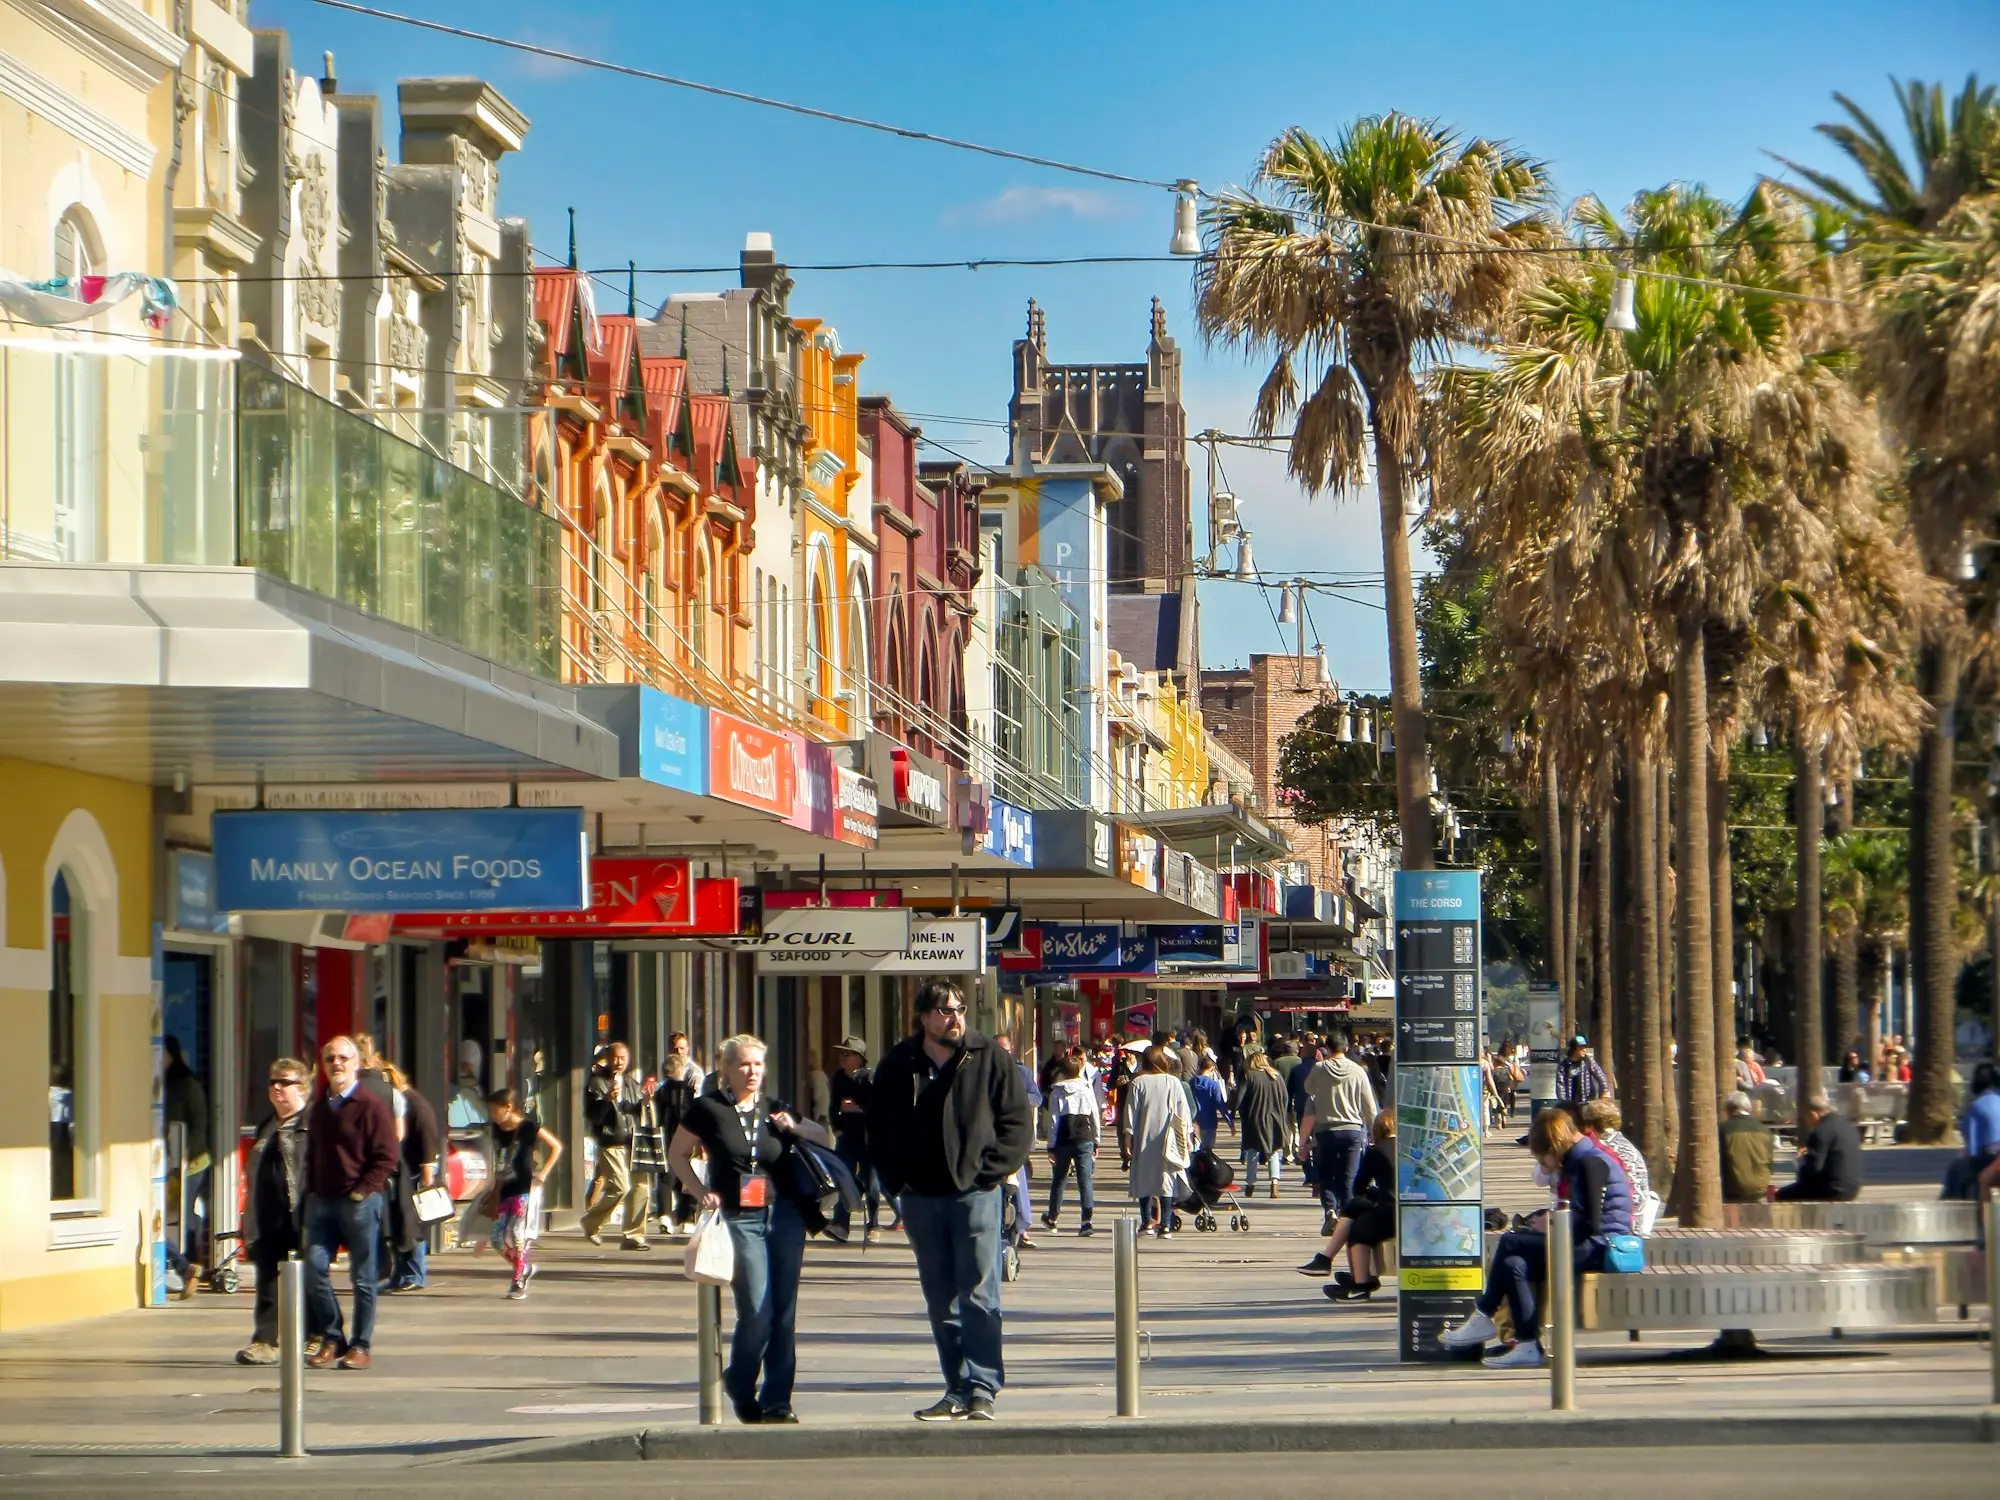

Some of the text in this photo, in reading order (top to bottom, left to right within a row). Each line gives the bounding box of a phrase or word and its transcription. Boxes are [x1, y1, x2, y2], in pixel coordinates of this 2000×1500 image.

[251, 855, 541, 881] MANLY OCEAN FOODS
[1411, 897, 1462, 908] THE CORSO
[446, 910, 598, 925] ICE CREAM
[782, 932, 856, 945] CURL
[1160, 937, 1219, 946] SACRED SPACE
[770, 951, 831, 962] SEAFOOD
[898, 949, 965, 961] TAKEAWAY
